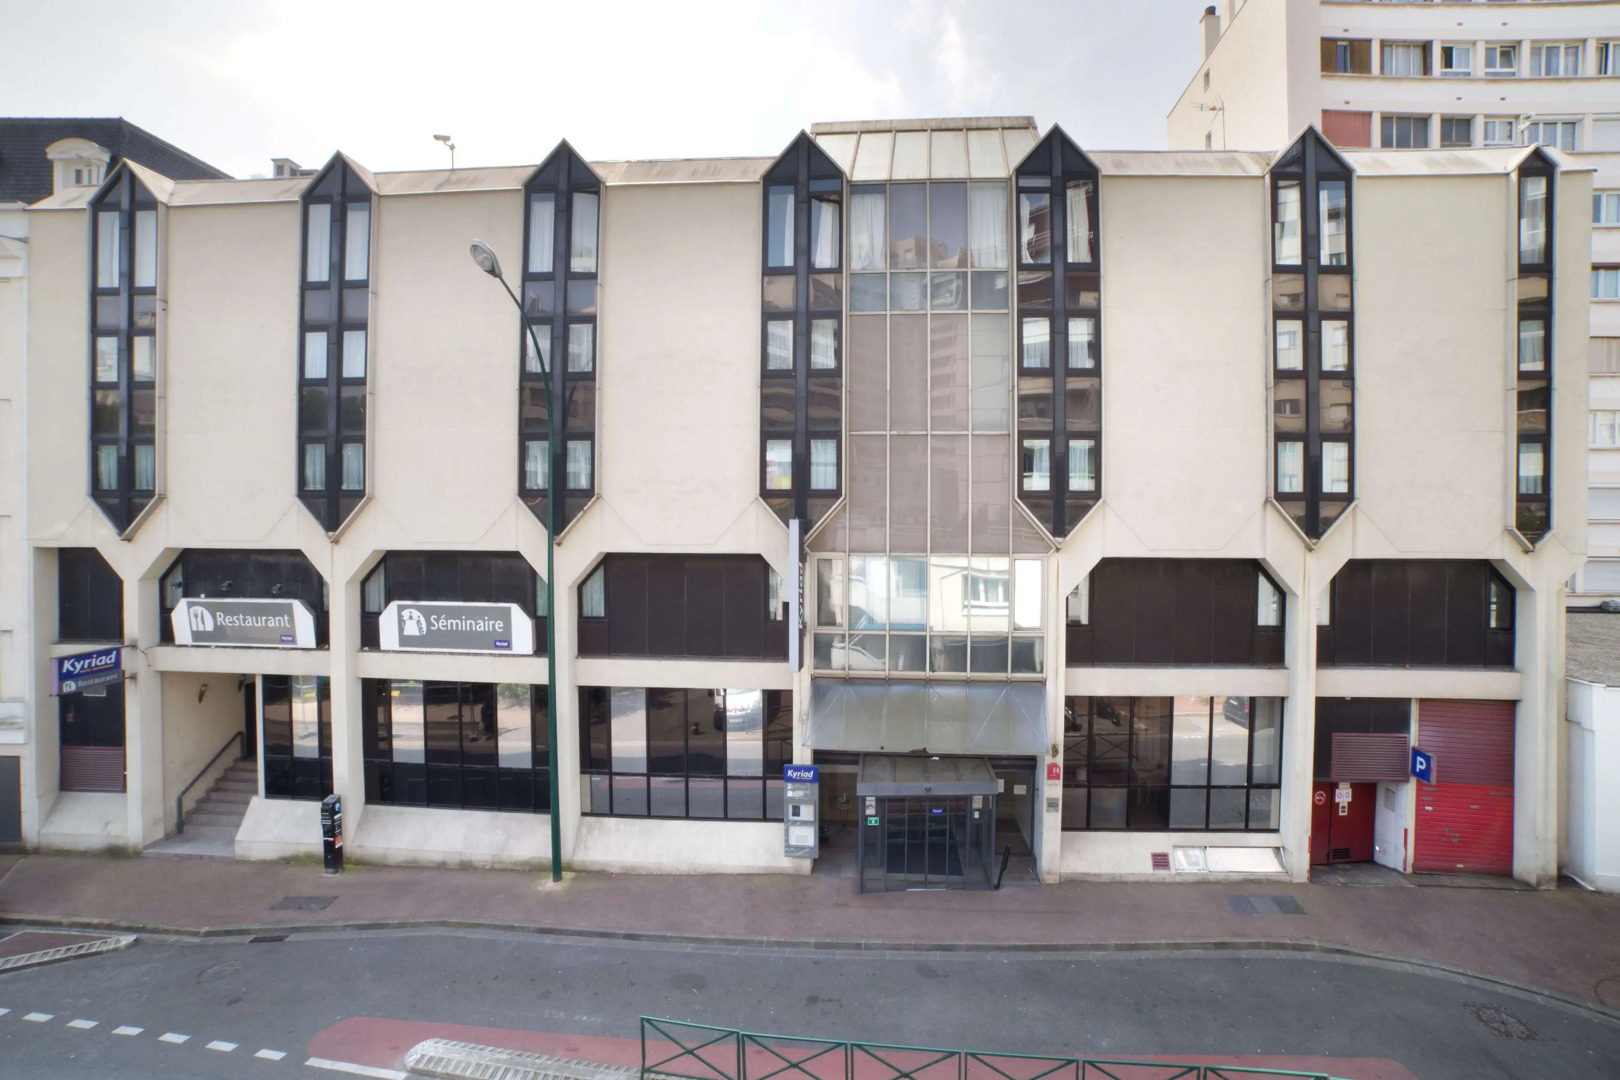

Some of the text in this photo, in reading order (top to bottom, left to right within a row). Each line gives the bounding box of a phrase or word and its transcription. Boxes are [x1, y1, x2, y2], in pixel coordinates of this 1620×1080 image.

[216, 611, 291, 628] Restaurant
[430, 614, 504, 632] Séminaire
[62, 650, 117, 674] Kyriad
[77, 673, 118, 688] Restaurant
[1416, 755, 1427, 773] P
[787, 769, 814, 779] Kyriad
